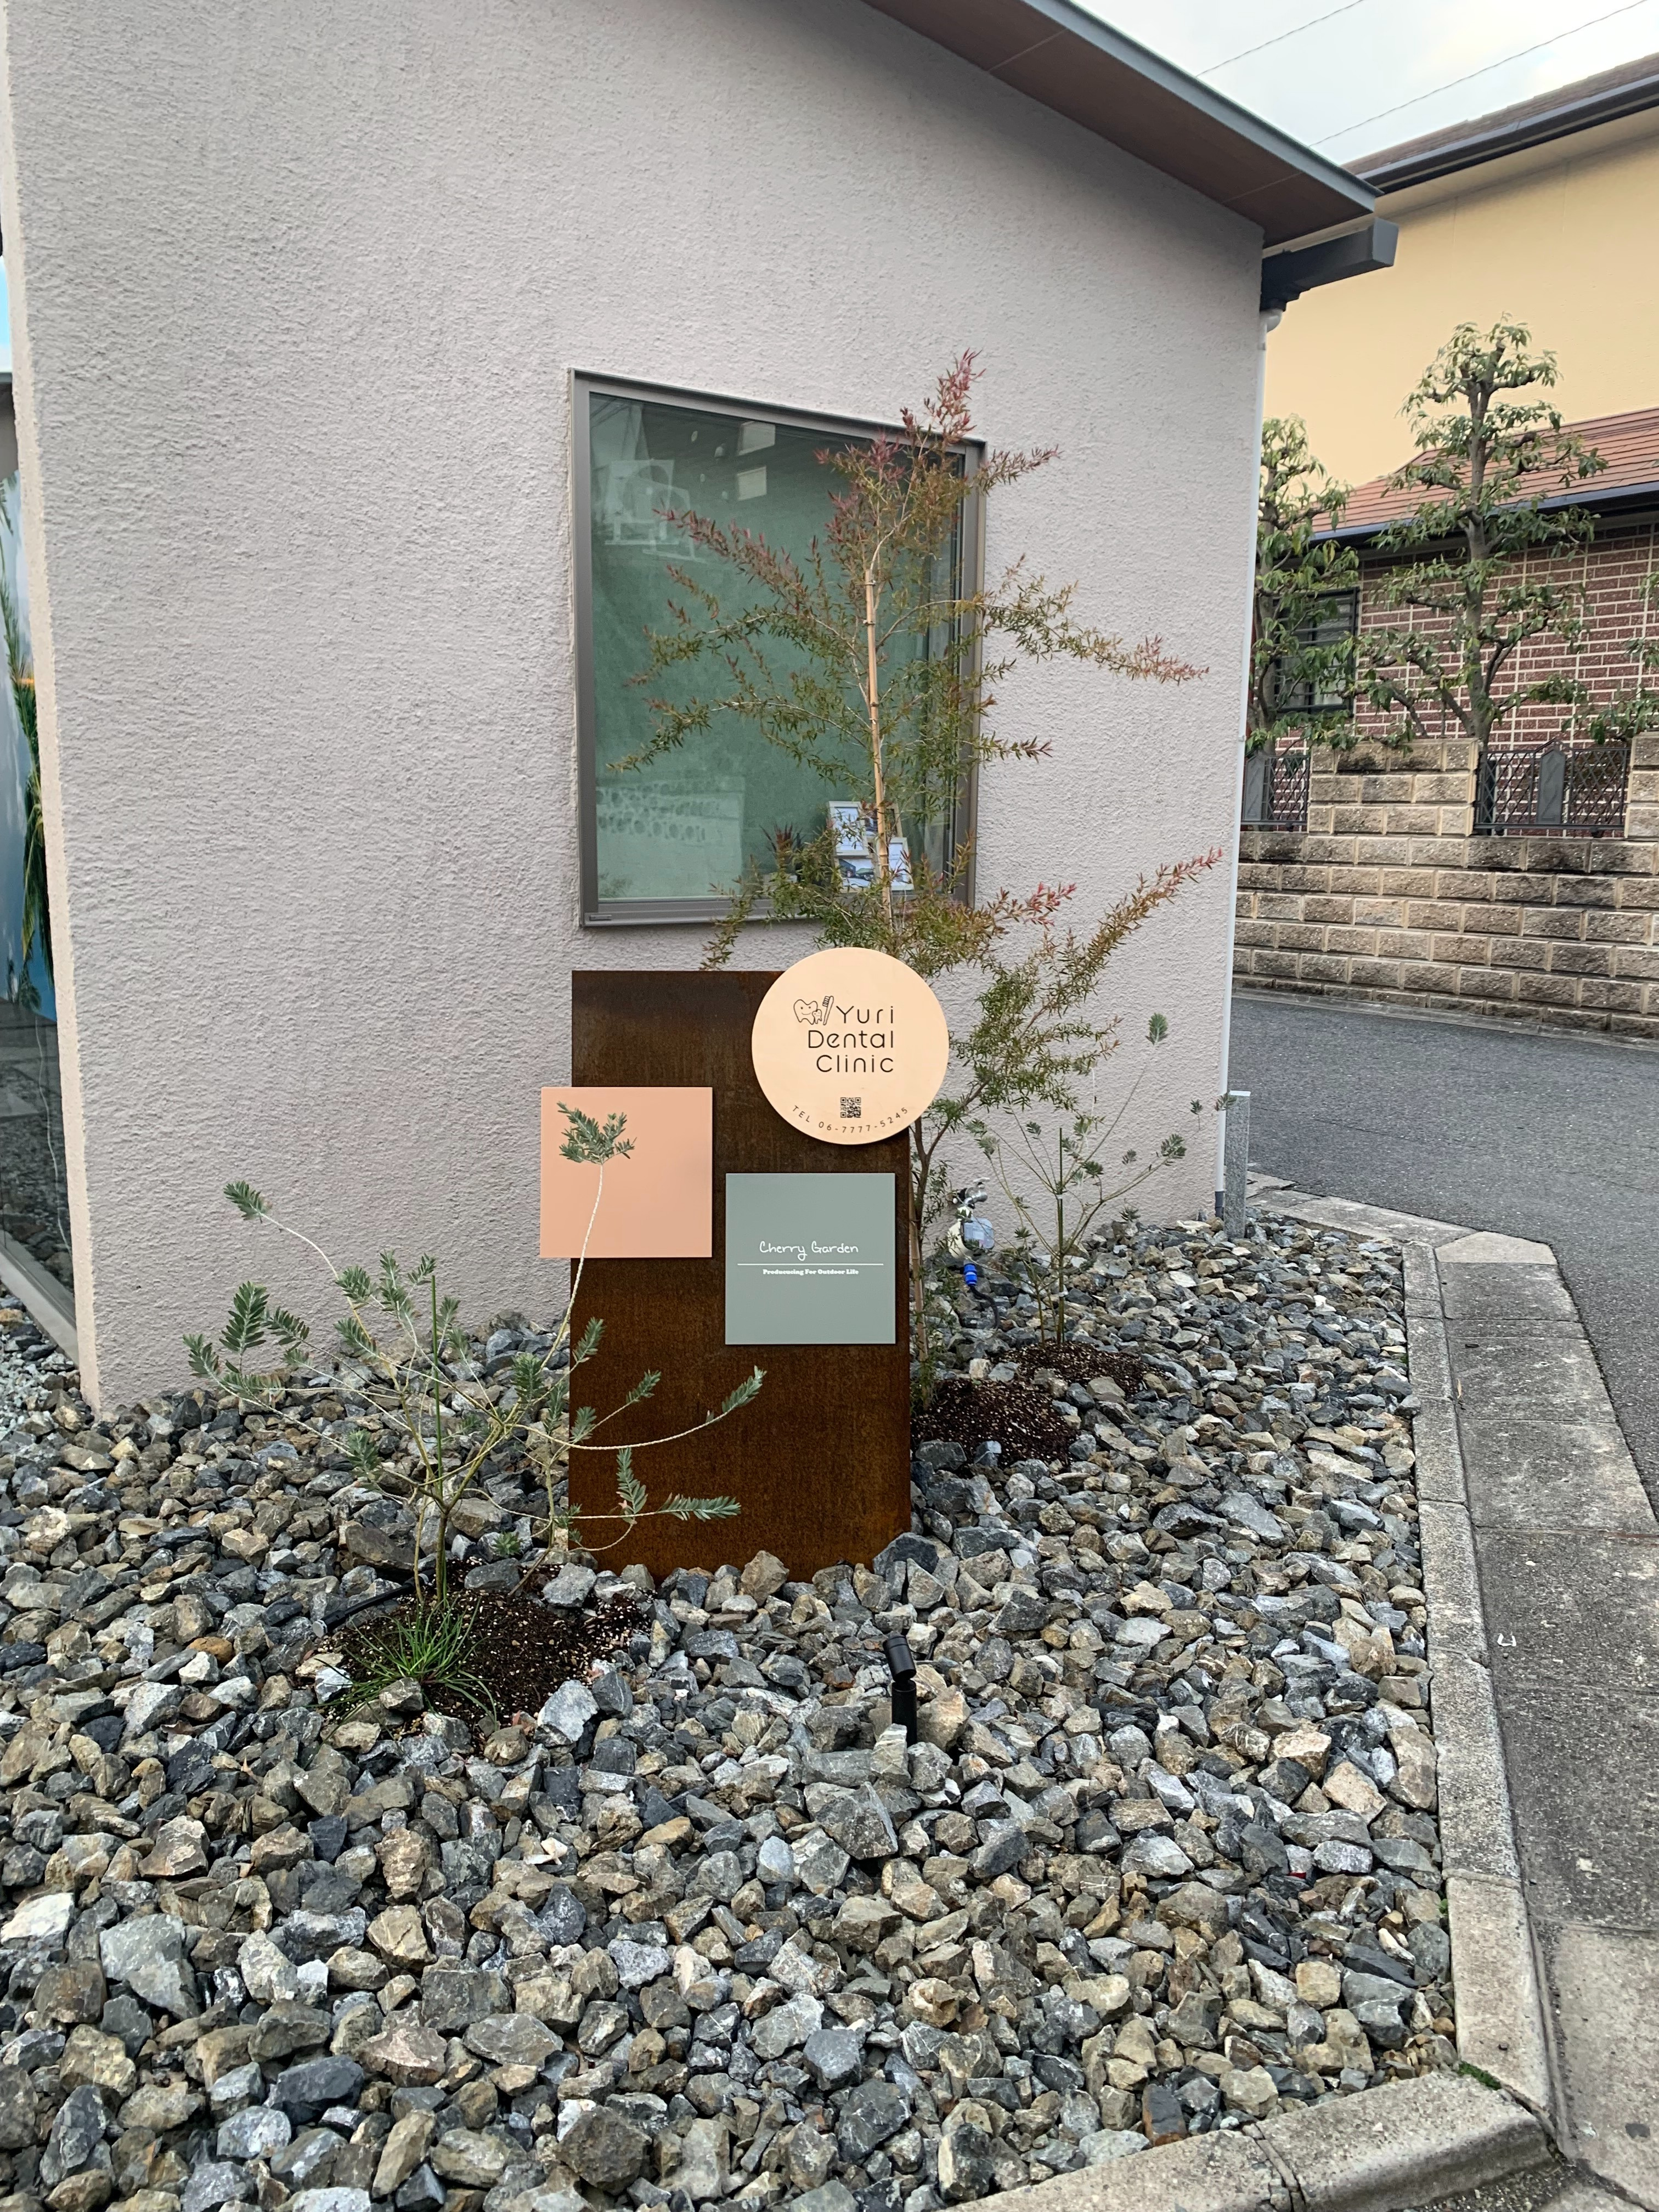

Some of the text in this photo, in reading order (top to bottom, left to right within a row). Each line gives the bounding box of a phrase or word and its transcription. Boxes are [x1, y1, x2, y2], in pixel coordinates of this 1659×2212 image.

[836, 1006, 894, 1024] Yuri
[809, 1030, 894, 1048] Dental
[816, 1054, 894, 1073] Clinic
[792, 1105, 908, 1133] TEL 06-7777-5245
[759, 1240, 859, 1261] Cherry Garden
